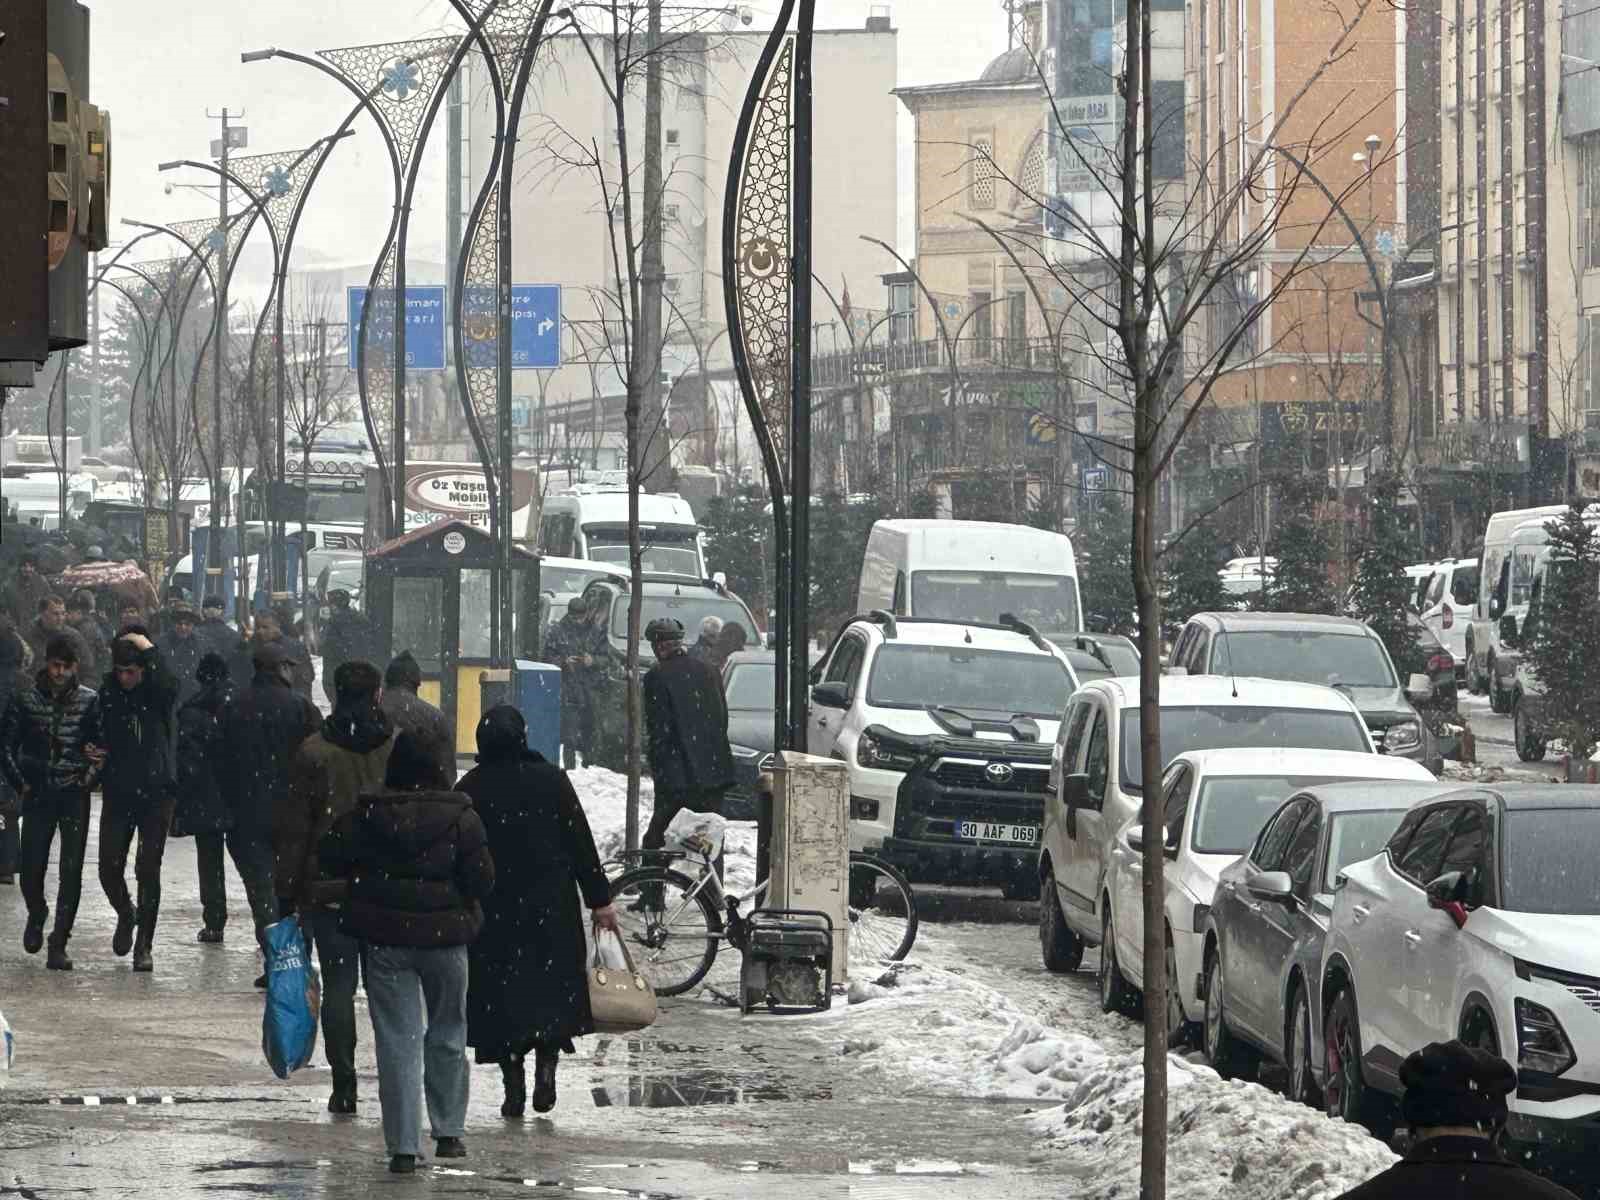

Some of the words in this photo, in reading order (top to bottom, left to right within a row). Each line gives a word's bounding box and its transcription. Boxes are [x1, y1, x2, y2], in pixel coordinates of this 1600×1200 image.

[448, 491, 487, 503] Mobil
[962, 823, 977, 837] 30
[983, 823, 1005, 839] AAF
[1012, 826, 1034, 841] 069
